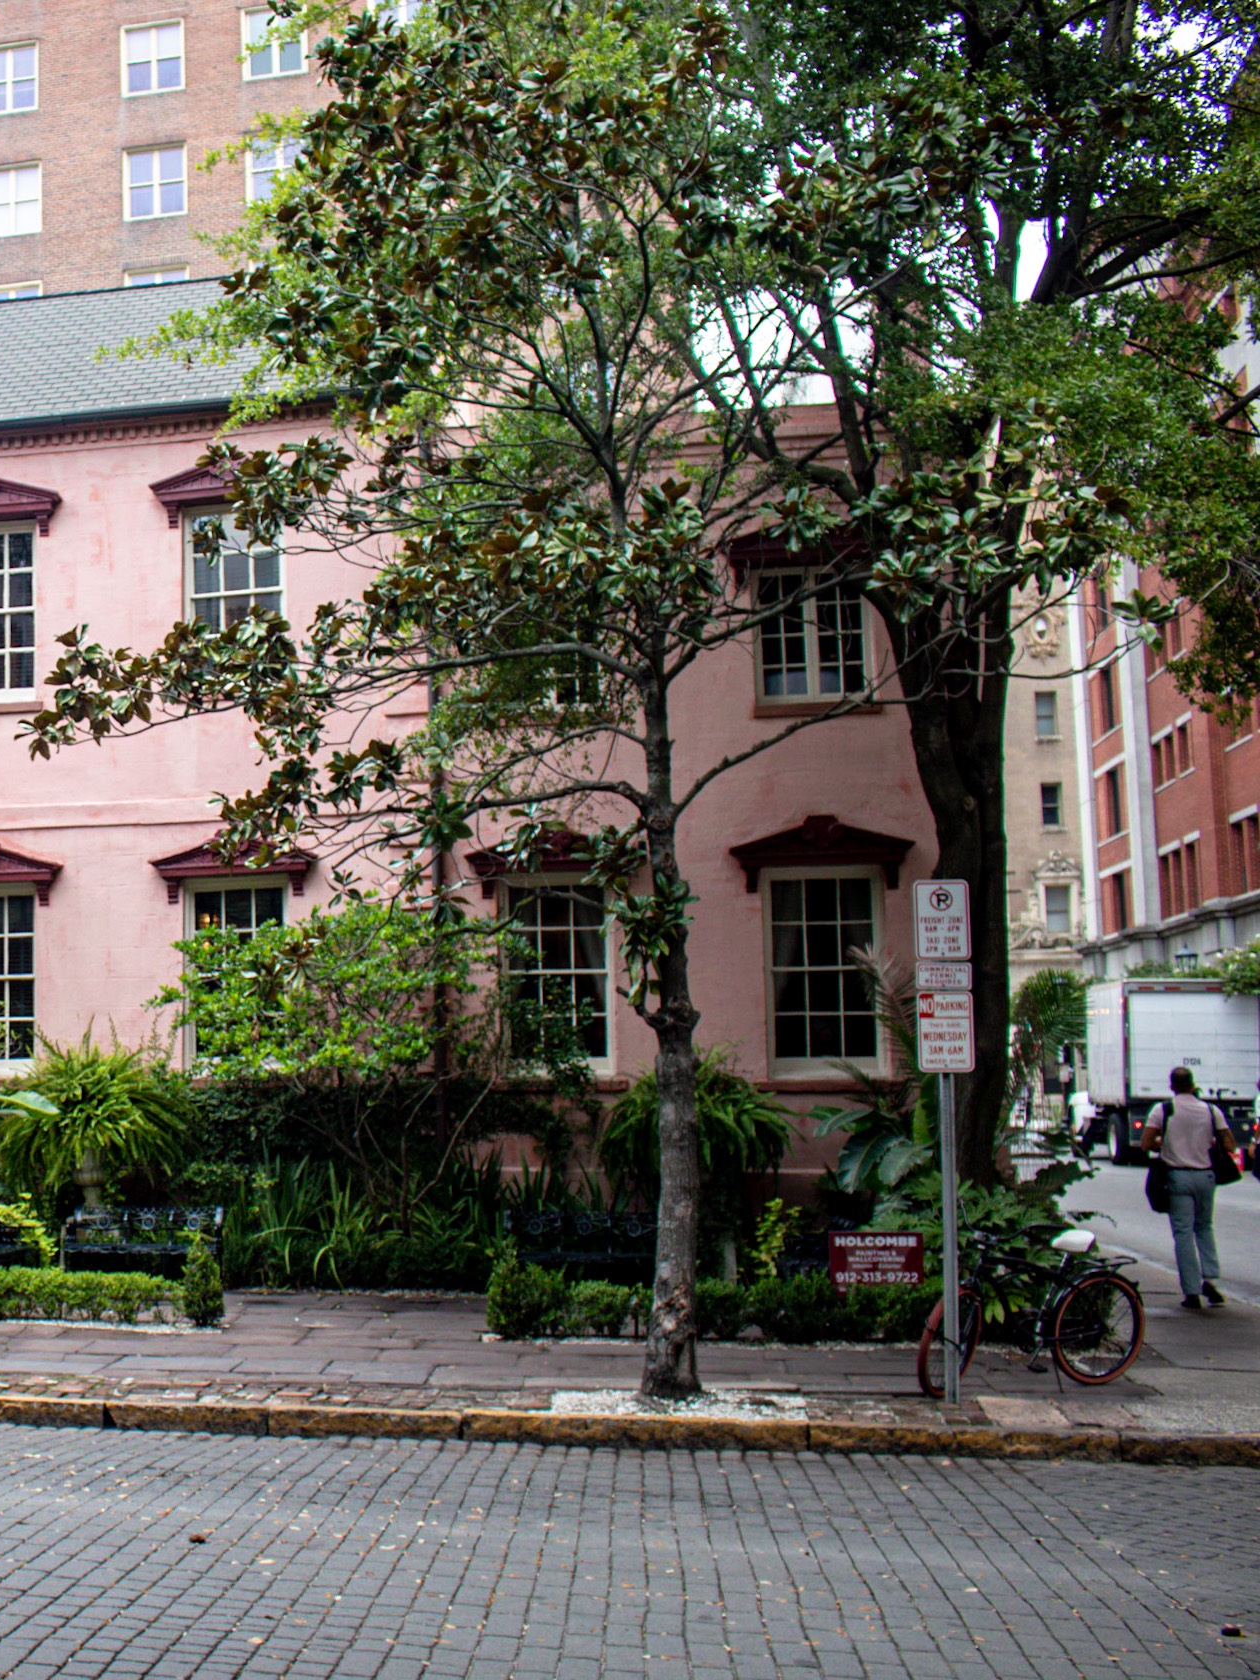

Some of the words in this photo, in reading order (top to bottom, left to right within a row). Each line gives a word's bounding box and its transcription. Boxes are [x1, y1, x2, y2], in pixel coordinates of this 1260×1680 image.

[920, 916, 945, 924] FREIGHT
[949, 916, 963, 924] ZONE
[944, 936, 959, 944] ZONE
[920, 998, 934, 1013] NO
[935, 1002, 968, 1011] PARKING
[923, 1032, 967, 1042] WEDNESDAY
[834, 1236, 917, 1247] HOLCOMBE
[836, 1272, 918, 1283] 912-313-9722
